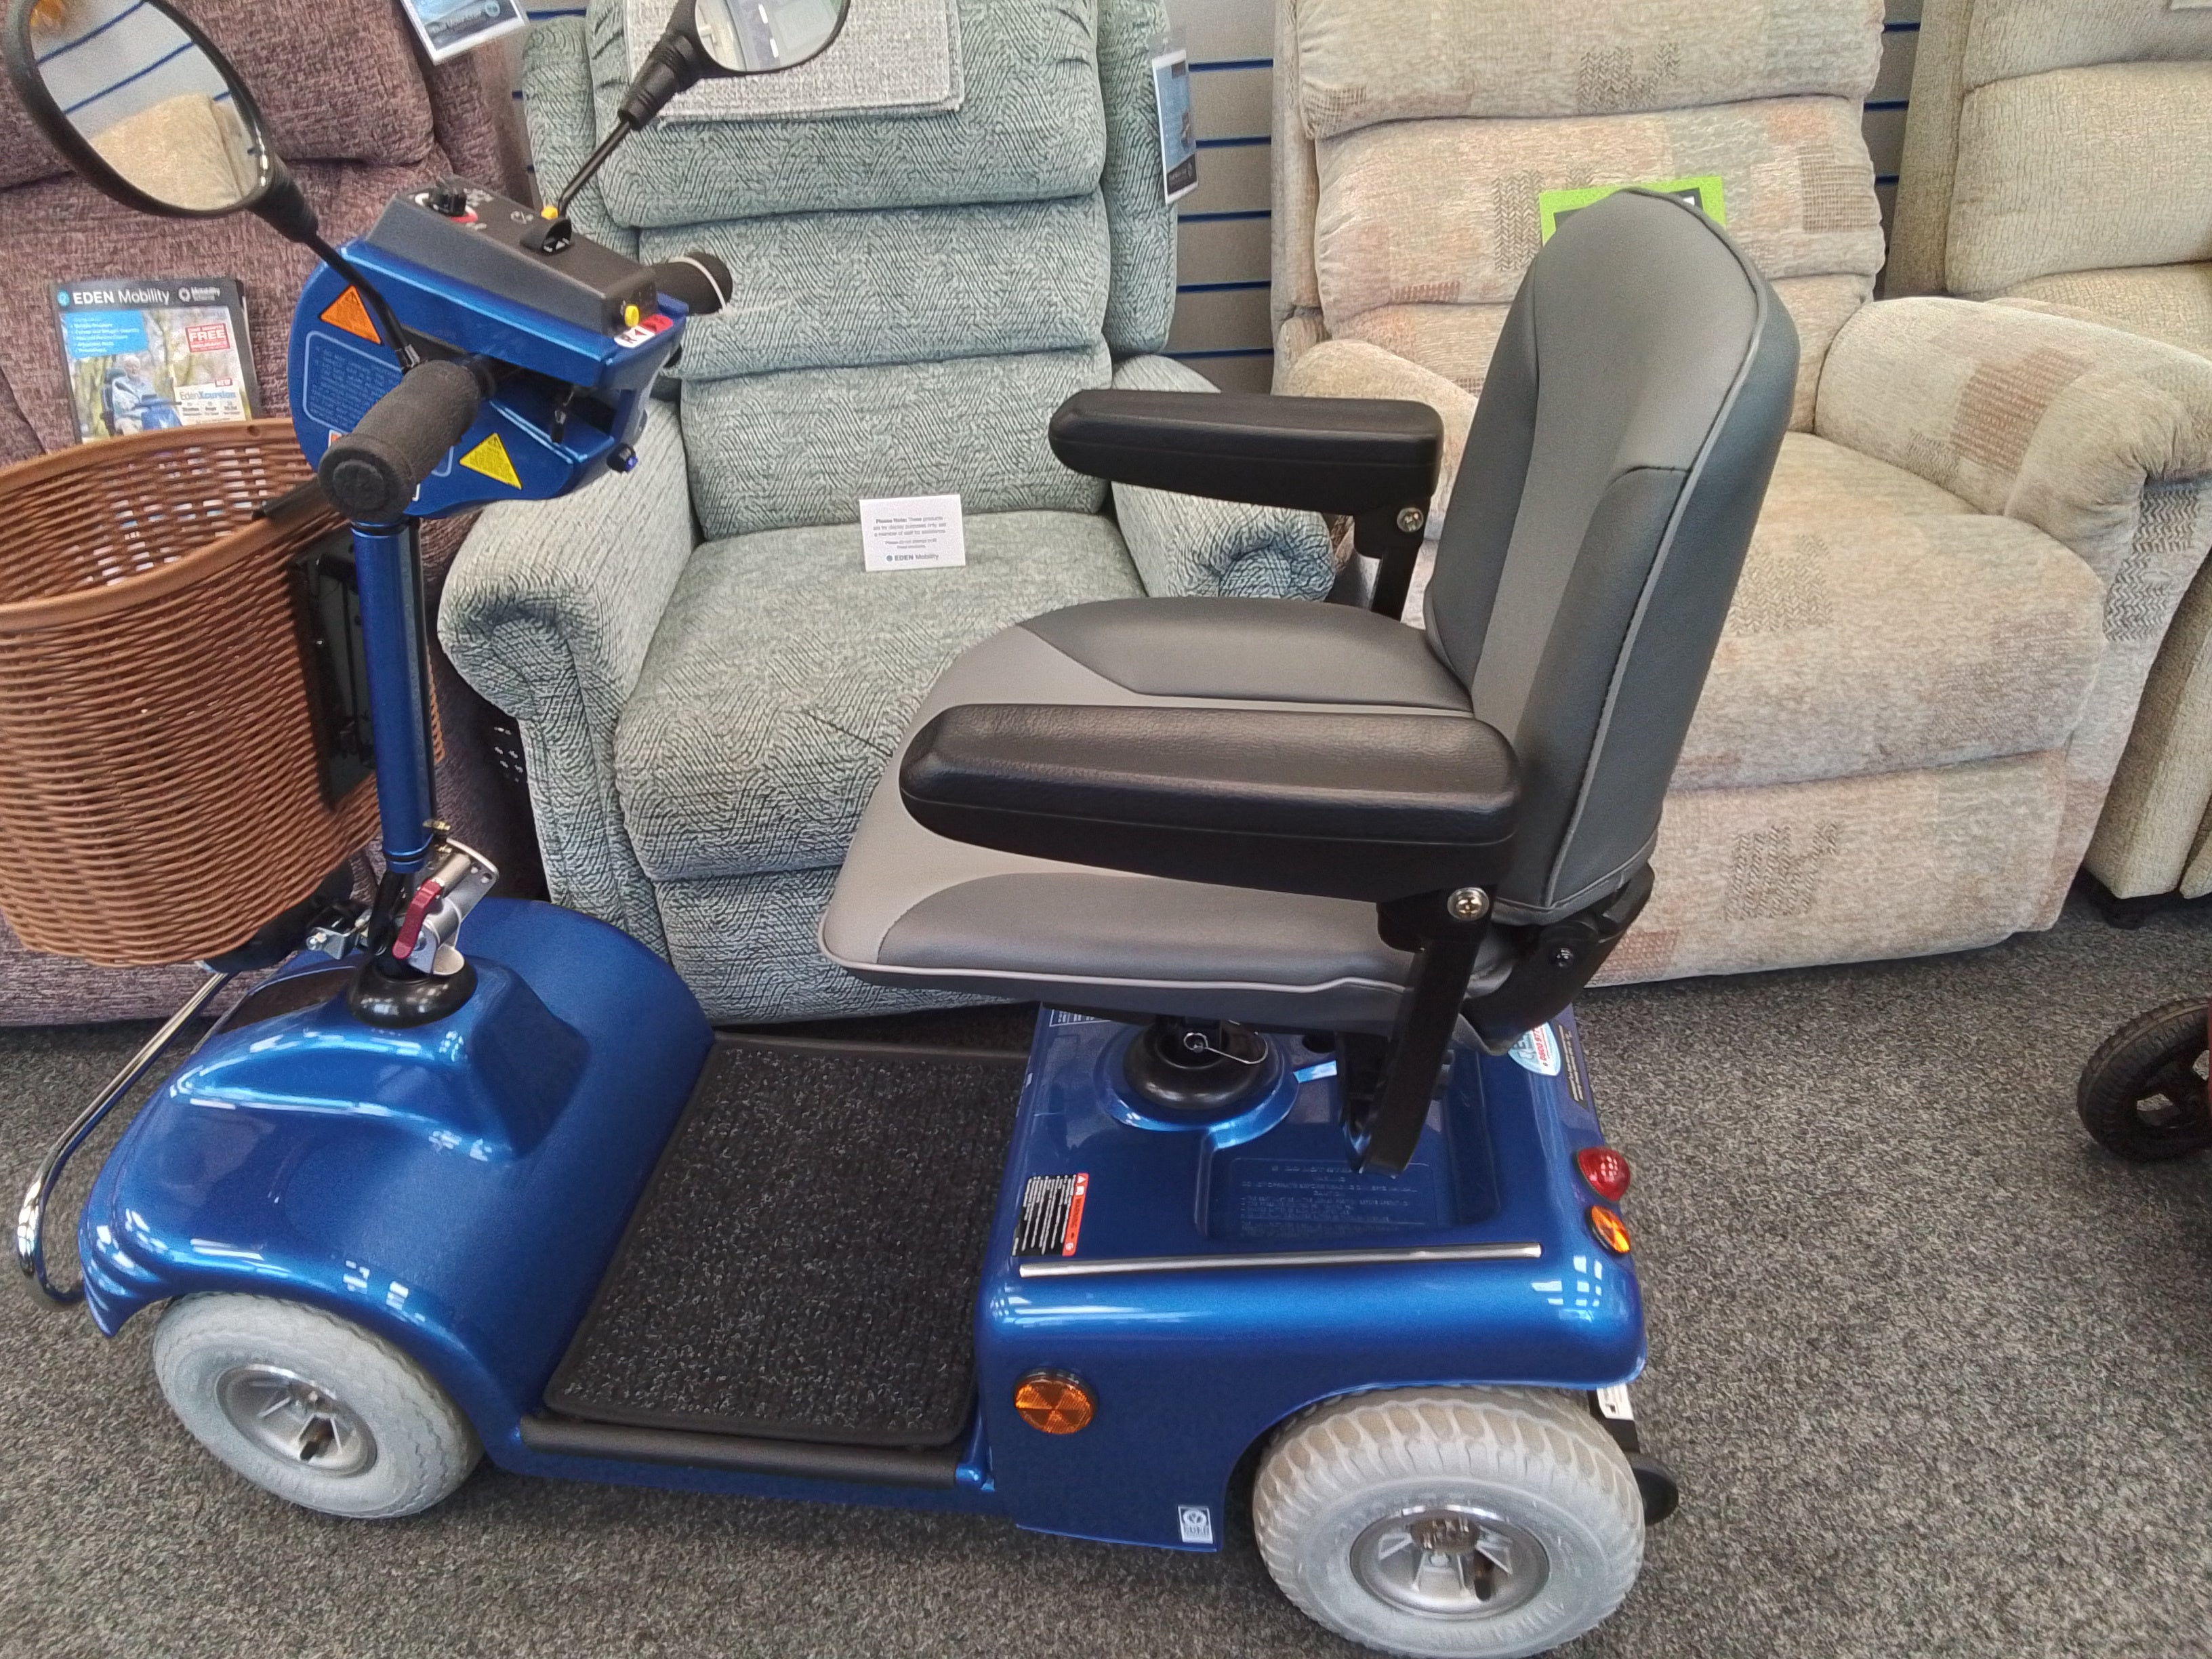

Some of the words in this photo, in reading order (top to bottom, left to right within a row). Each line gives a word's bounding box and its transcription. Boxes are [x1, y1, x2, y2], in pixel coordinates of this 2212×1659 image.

[73, 291, 115, 304] EDEN
[118, 287, 170, 306] Mobility
[188, 329, 226, 342] FREE
